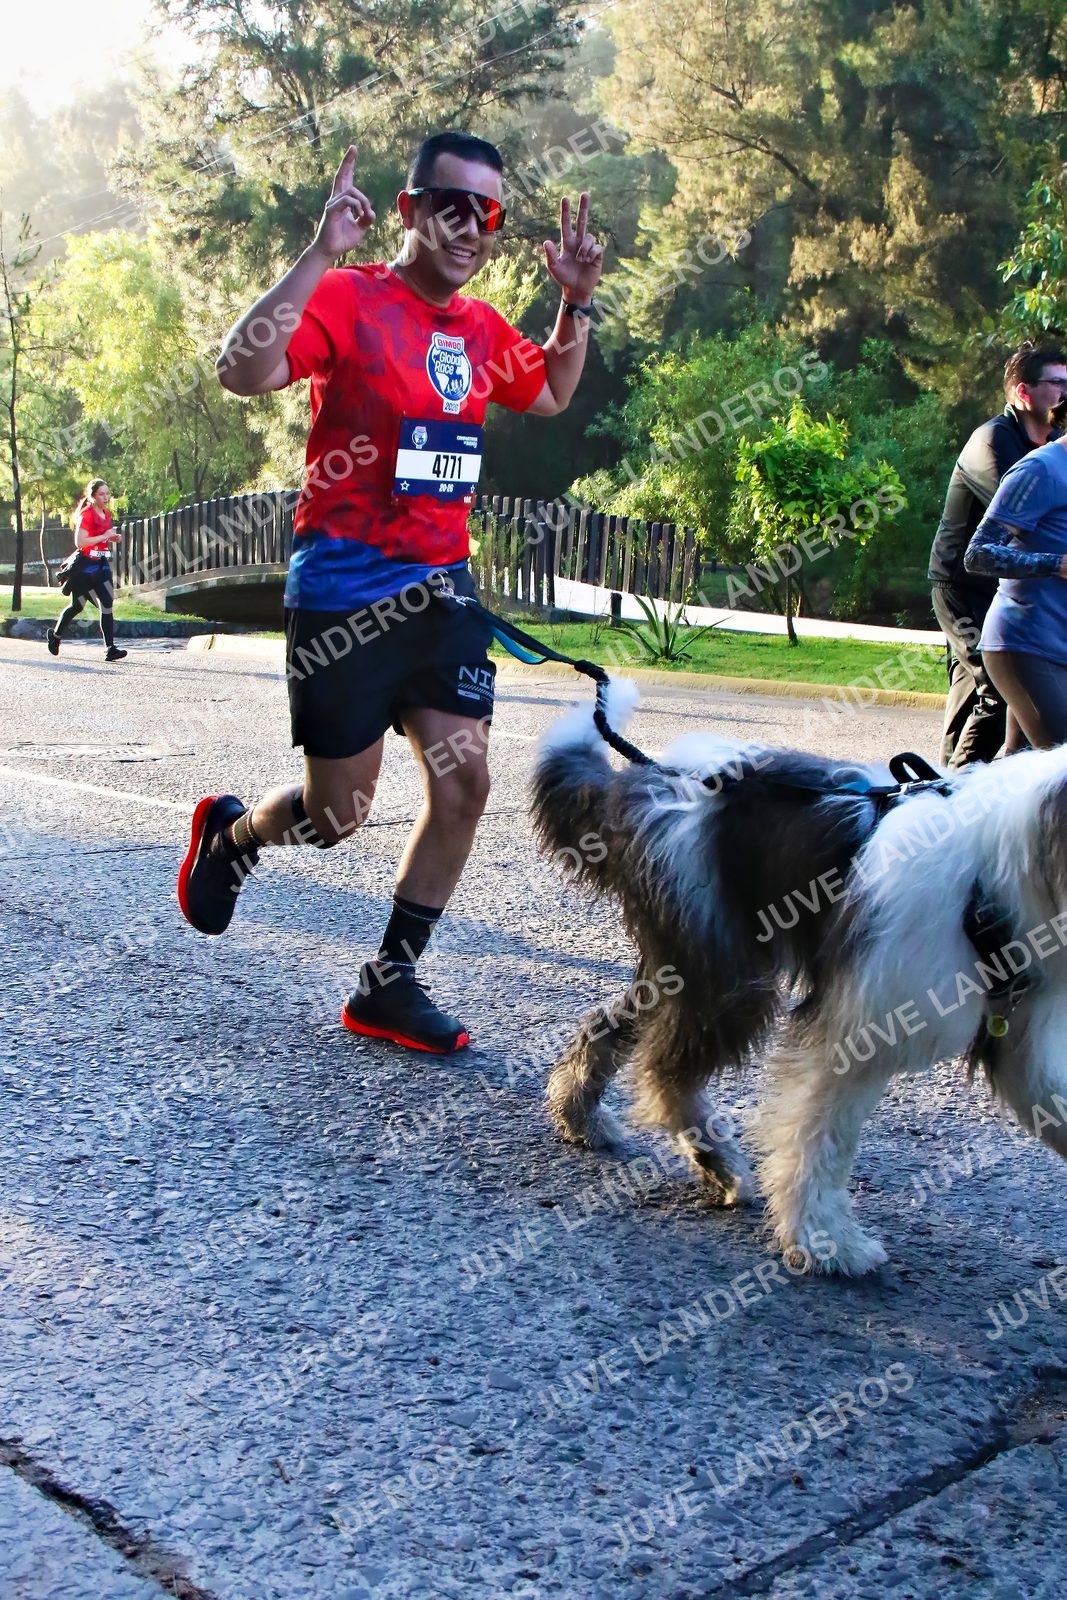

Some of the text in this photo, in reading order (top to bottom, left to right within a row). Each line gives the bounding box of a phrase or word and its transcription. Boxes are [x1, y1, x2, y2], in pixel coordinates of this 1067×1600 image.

[437, 338, 461, 351] BIMBO
[439, 351, 462, 367] Global
[434, 360, 454, 375] Race
[432, 453, 462, 479] 4771
